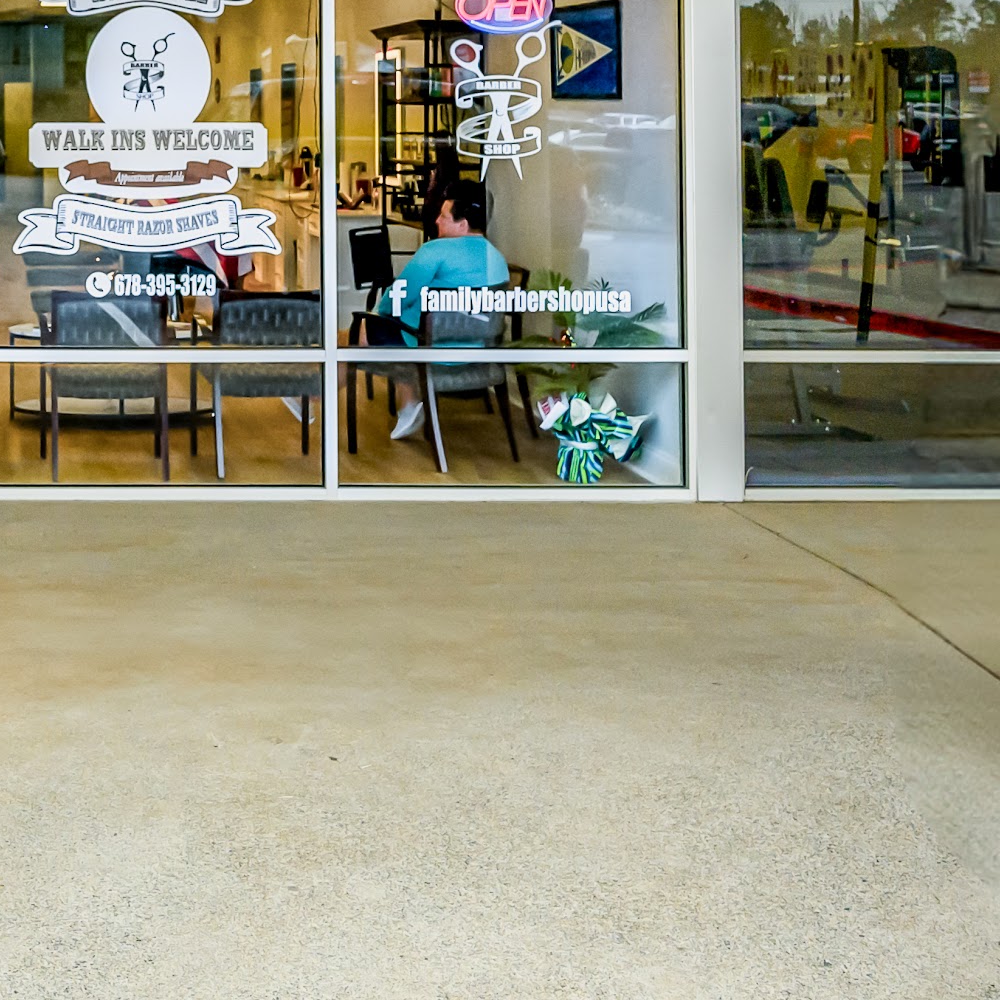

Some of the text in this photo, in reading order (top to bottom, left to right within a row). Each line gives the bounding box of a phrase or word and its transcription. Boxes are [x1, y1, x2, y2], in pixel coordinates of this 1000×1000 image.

[475, 80, 522, 90] BARBER
[42, 129, 255, 151] WALK INS WELCOME
[483, 143, 521, 155] SHOP
[71, 209, 219, 236] STRAIGHT RAZOR SHAVES
[114, 273, 217, 297] 678-395-3129
[420, 286, 632, 315] familybarbershopusa
